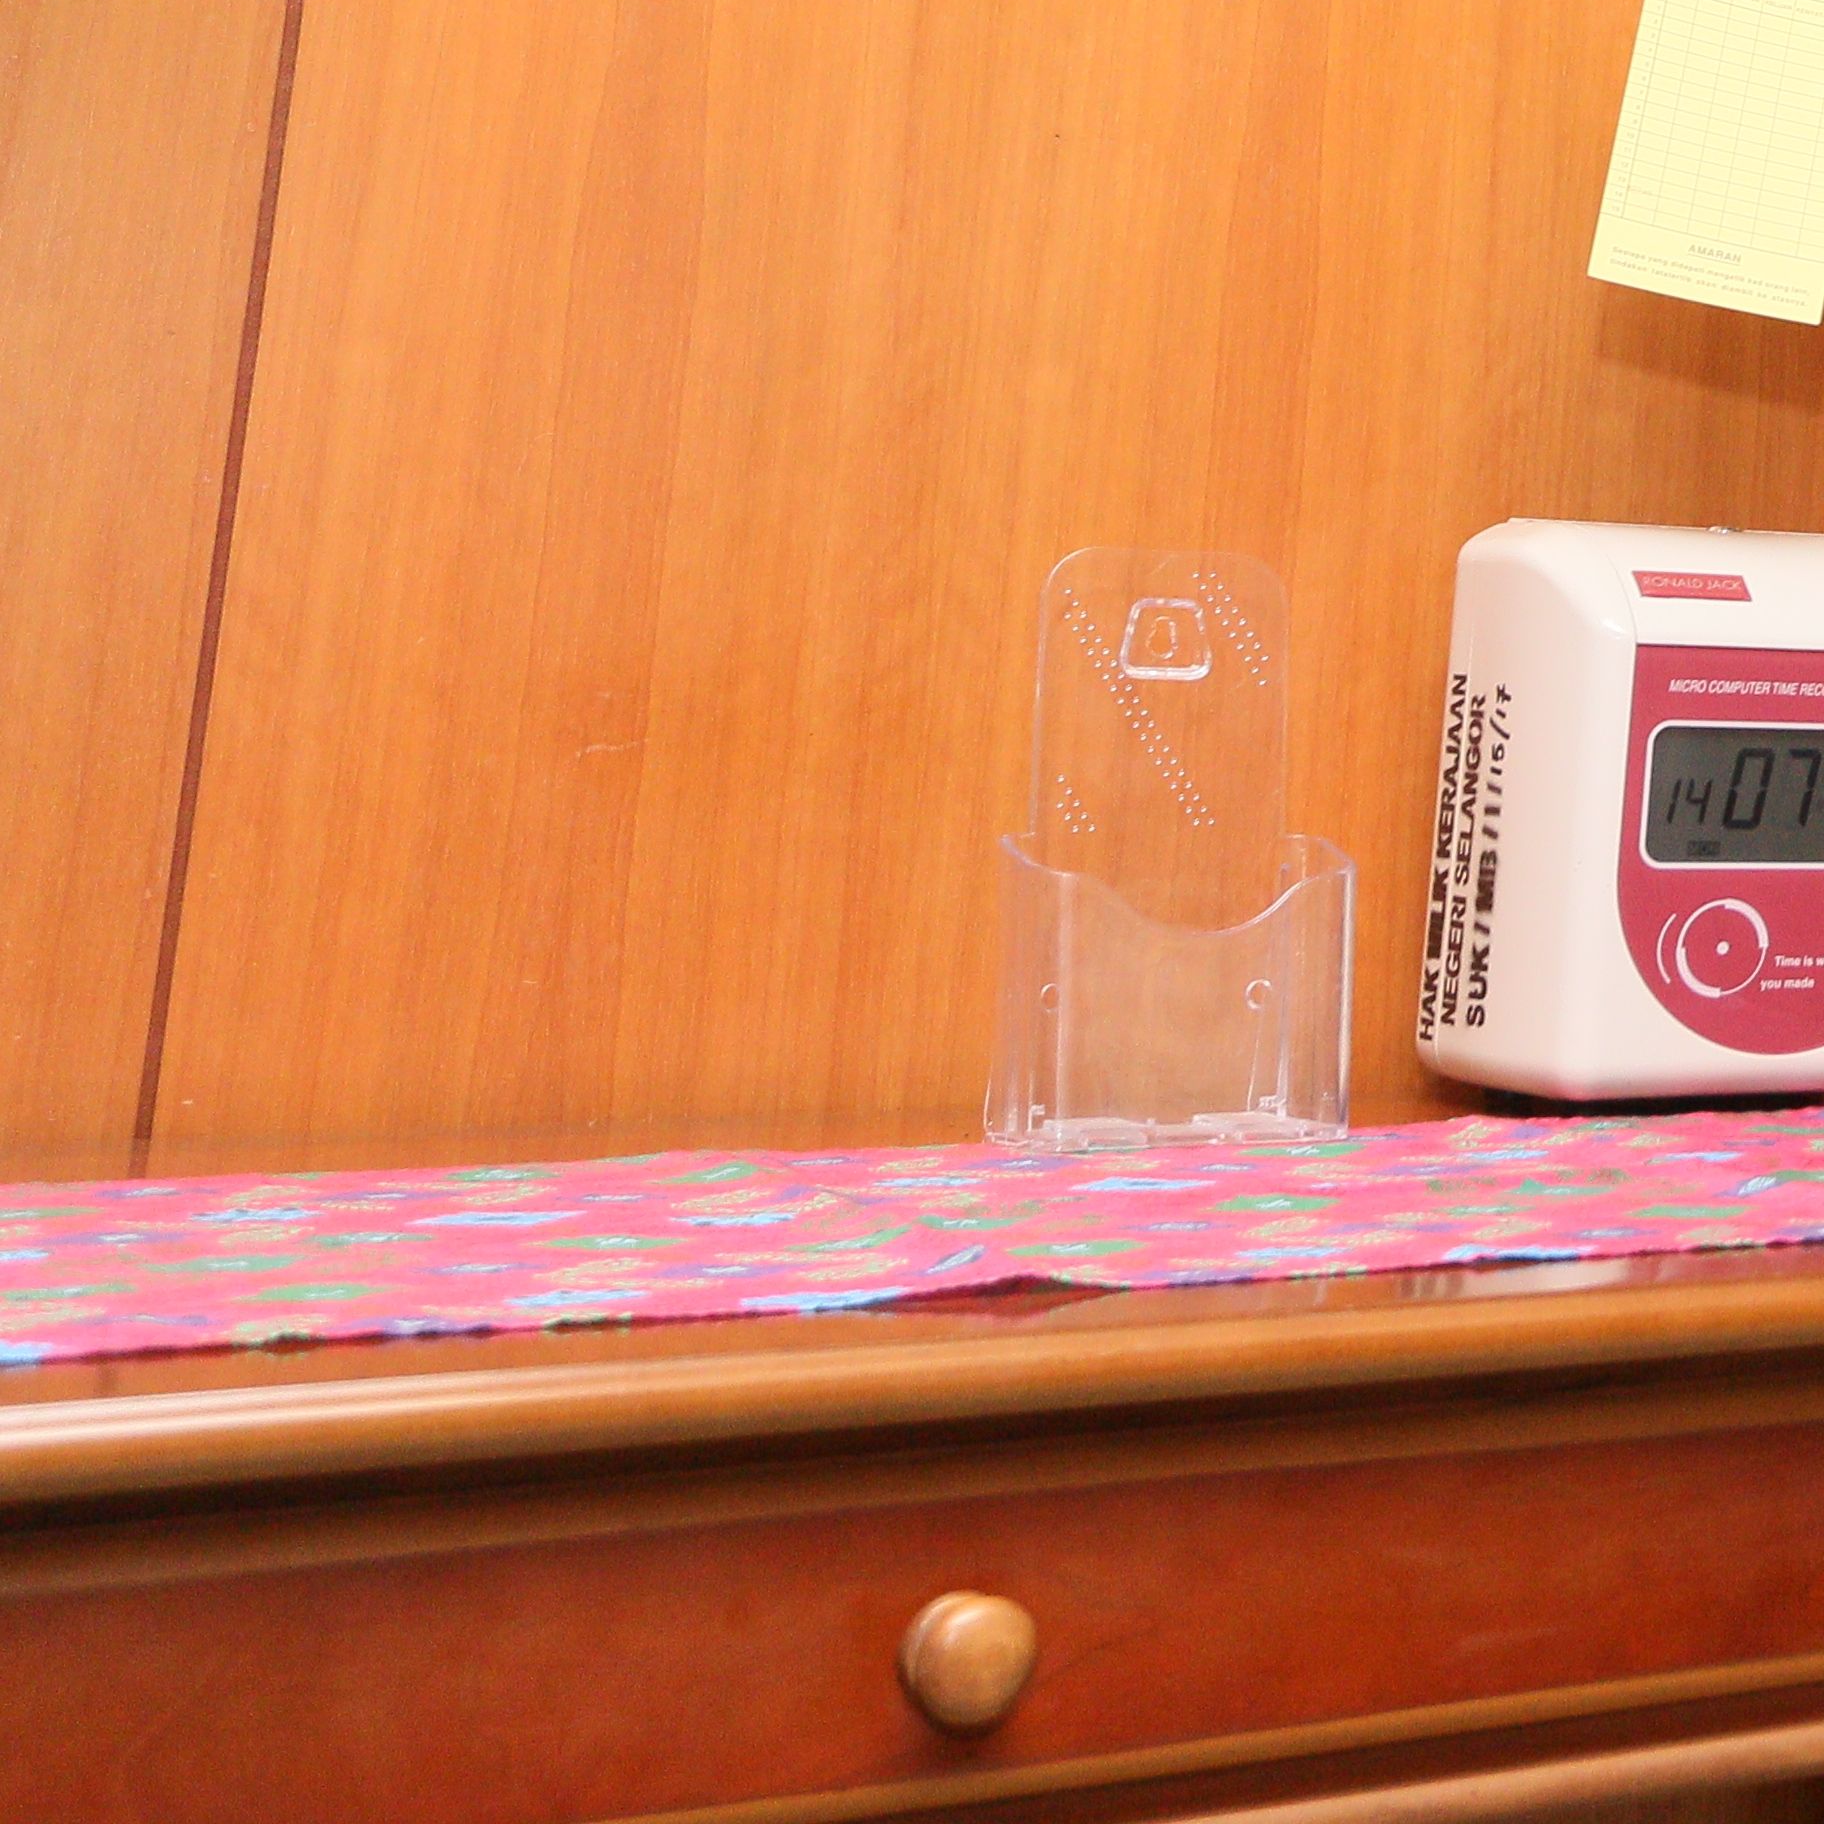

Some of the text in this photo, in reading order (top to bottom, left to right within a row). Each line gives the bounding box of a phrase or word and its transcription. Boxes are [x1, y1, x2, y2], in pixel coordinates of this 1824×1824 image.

[1687, 243, 1742, 262] AMARAN
[1707, 579, 1742, 591] JACK
[1668, 679, 1707, 693] MICRO
[1707, 680, 1770, 696] COMPUTER
[1772, 681, 1797, 696] TIME
[1666, 779, 1713, 824] 14
[1419, 967, 1440, 1041] HAK
[1436, 674, 1468, 859] KERAJAAN
[1440, 694, 1486, 1025] NEGERI SELANGOR
[1774, 955, 1801, 967] Time
[1803, 955, 1813, 967] is
[1760, 977, 1815, 992] you made
